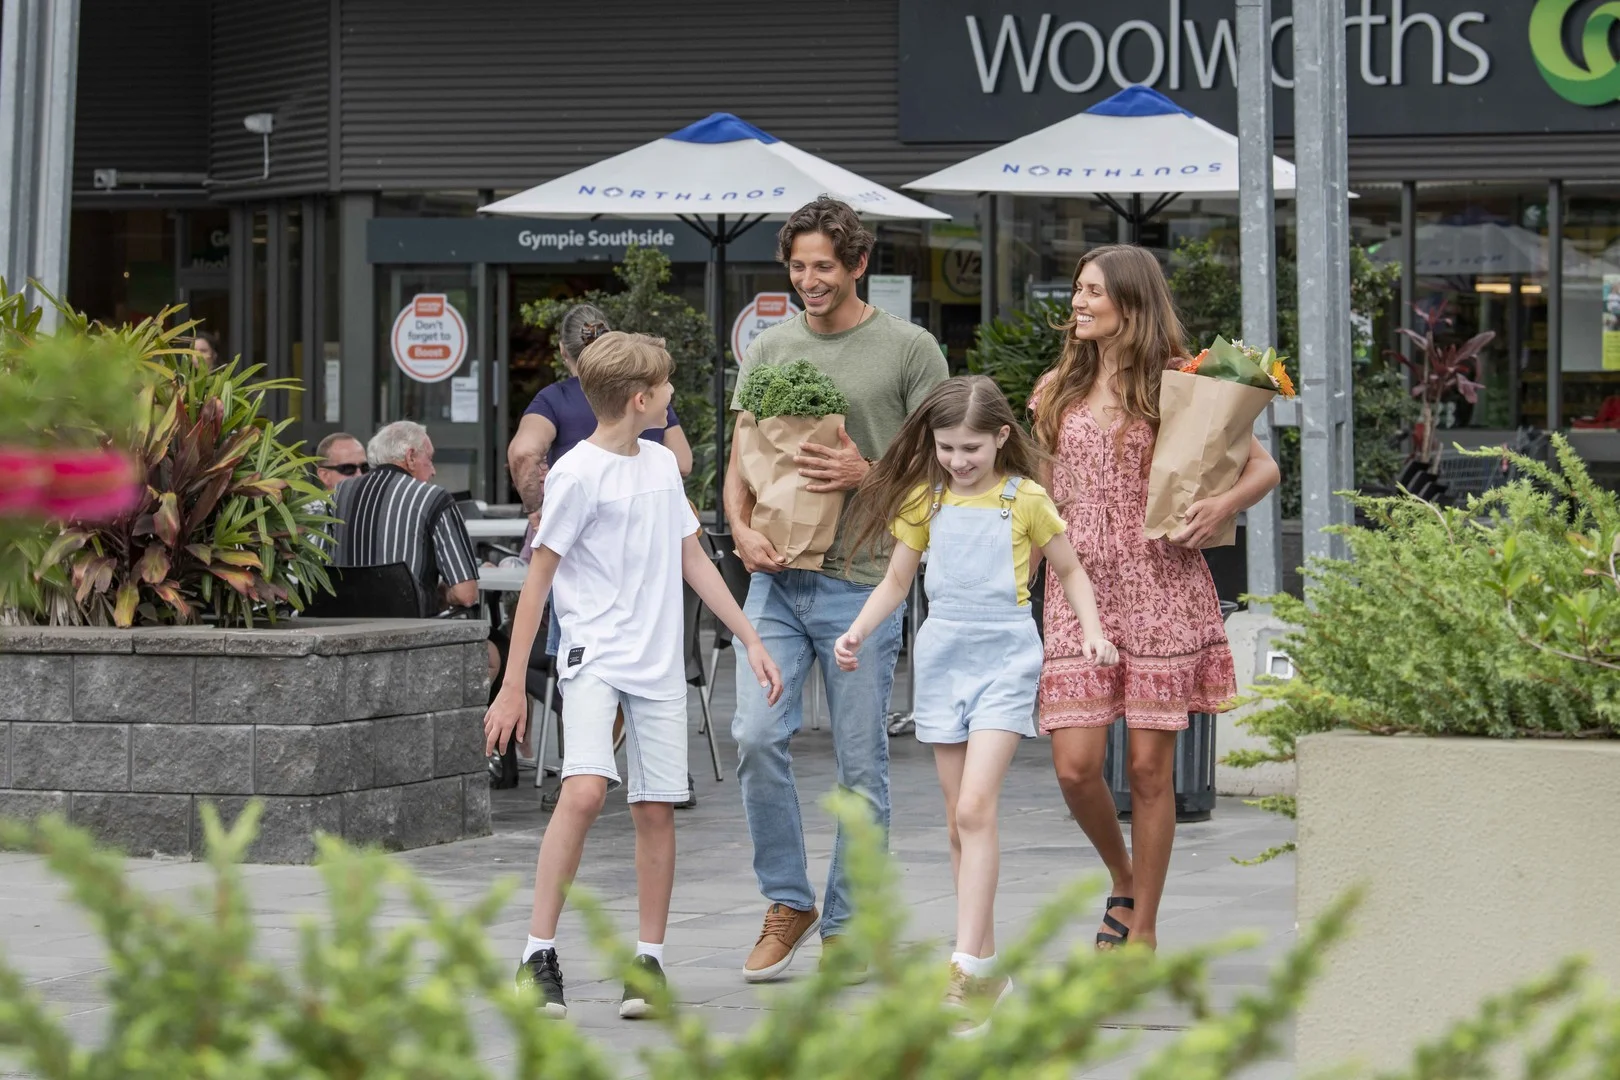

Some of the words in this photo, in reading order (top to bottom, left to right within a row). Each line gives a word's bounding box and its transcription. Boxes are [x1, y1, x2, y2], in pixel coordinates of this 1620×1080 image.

[518, 231, 584, 250] Gympie
[588, 228, 675, 247] Southside
[415, 319, 444, 330] Don't
[407, 331, 438, 344] forget
[440, 332, 452, 341] to
